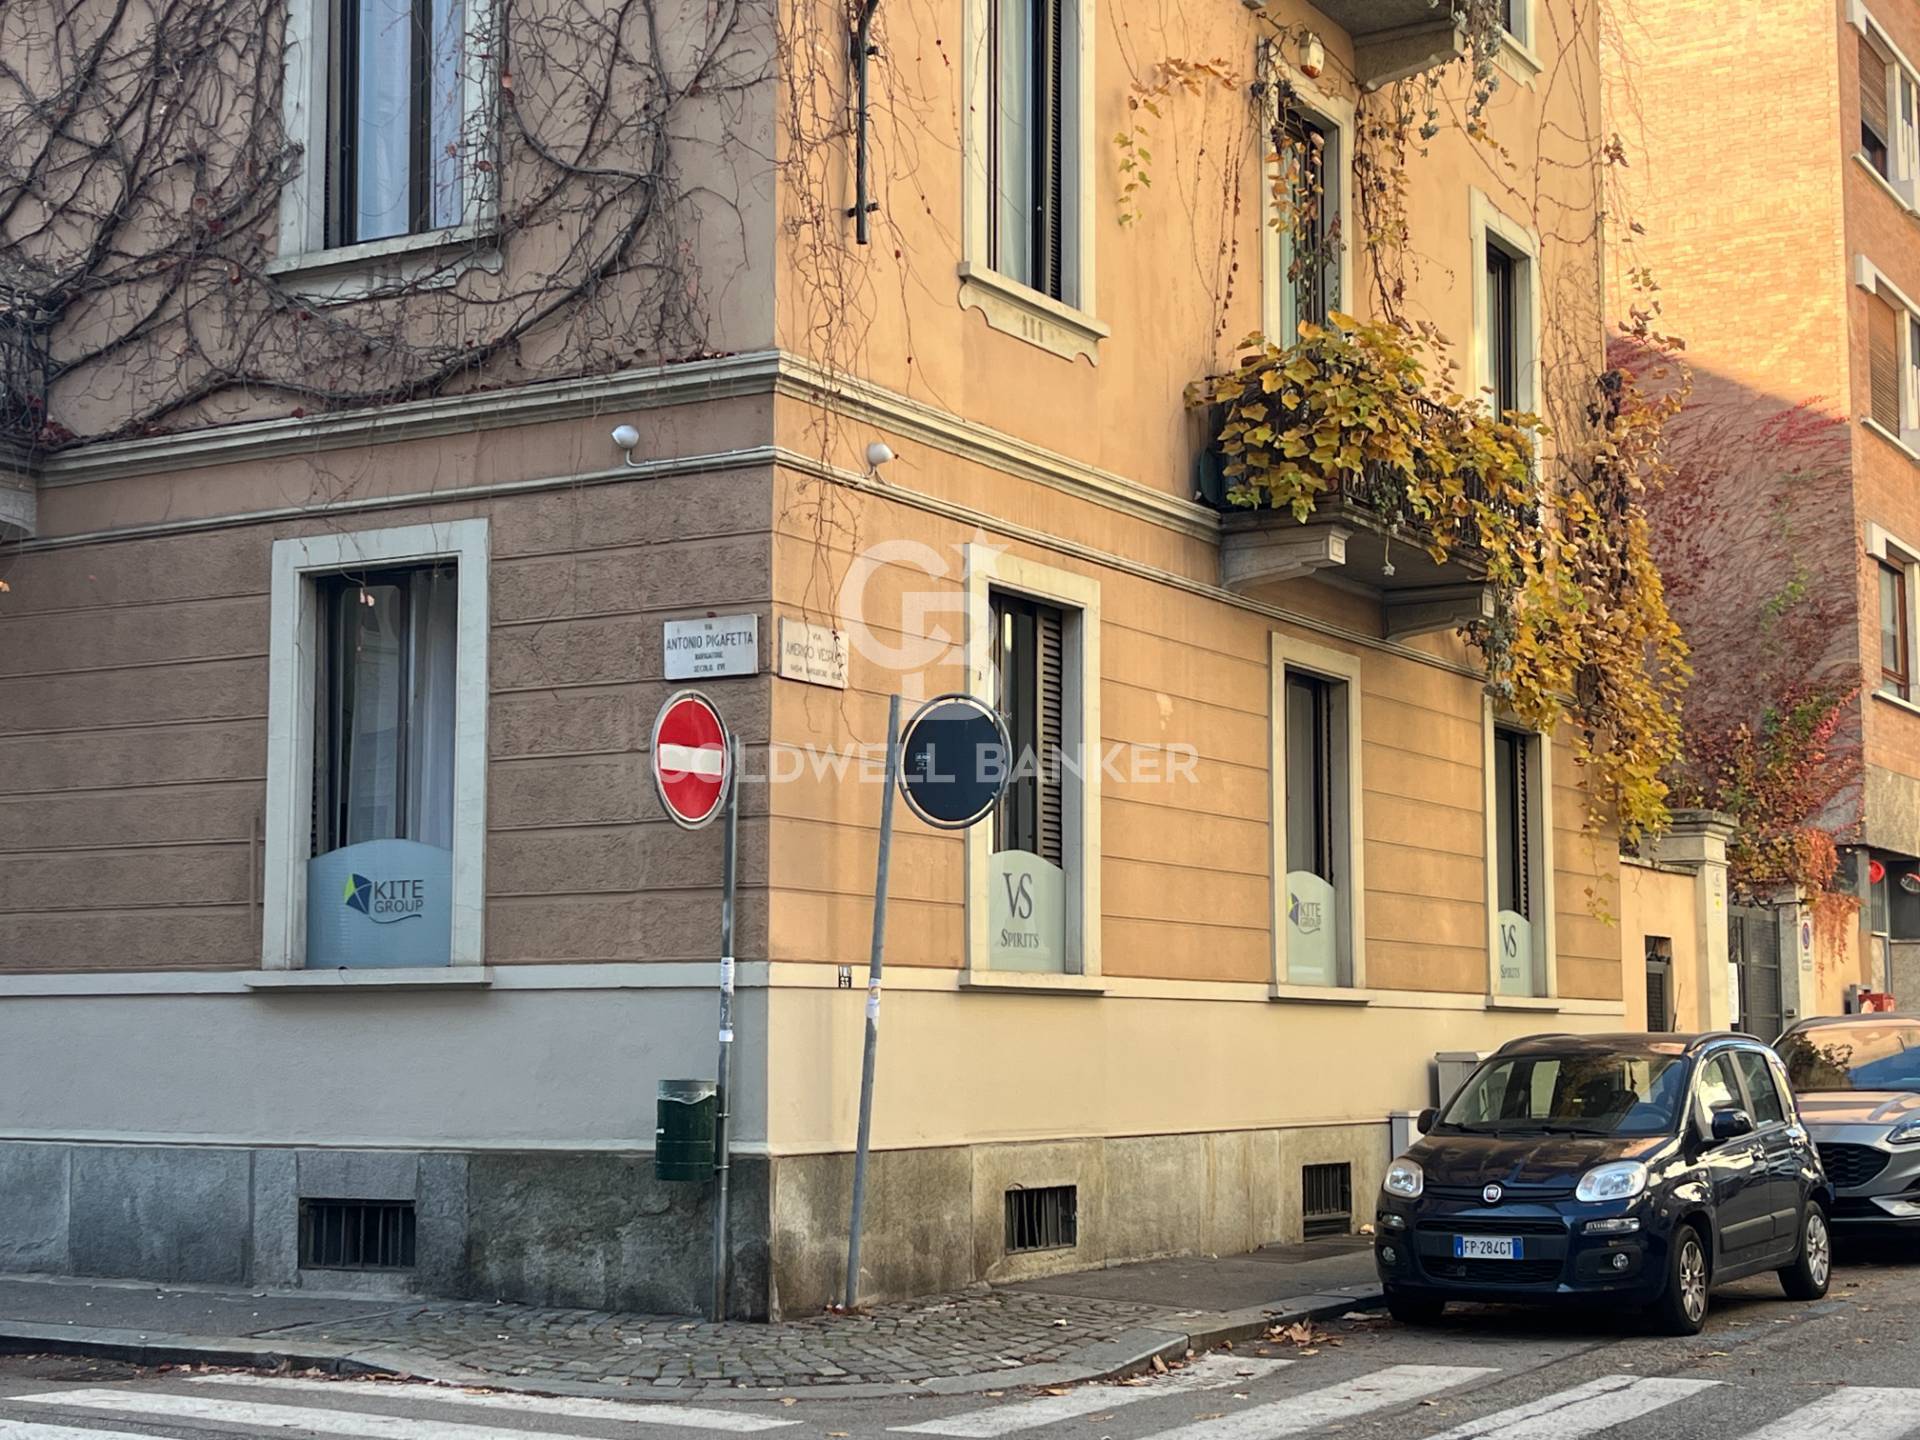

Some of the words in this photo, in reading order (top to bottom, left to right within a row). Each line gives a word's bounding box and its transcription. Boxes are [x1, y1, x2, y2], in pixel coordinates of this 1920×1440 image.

[666, 635, 703, 650] ANTONIO
[706, 631, 754, 648] PIGAFETTA
[374, 879, 424, 900] KITE
[1002, 872, 1033, 919] VS
[374, 899, 424, 914] GROUP
[1300, 902, 1321, 917] KITE
[1501, 924, 1517, 958] VS
